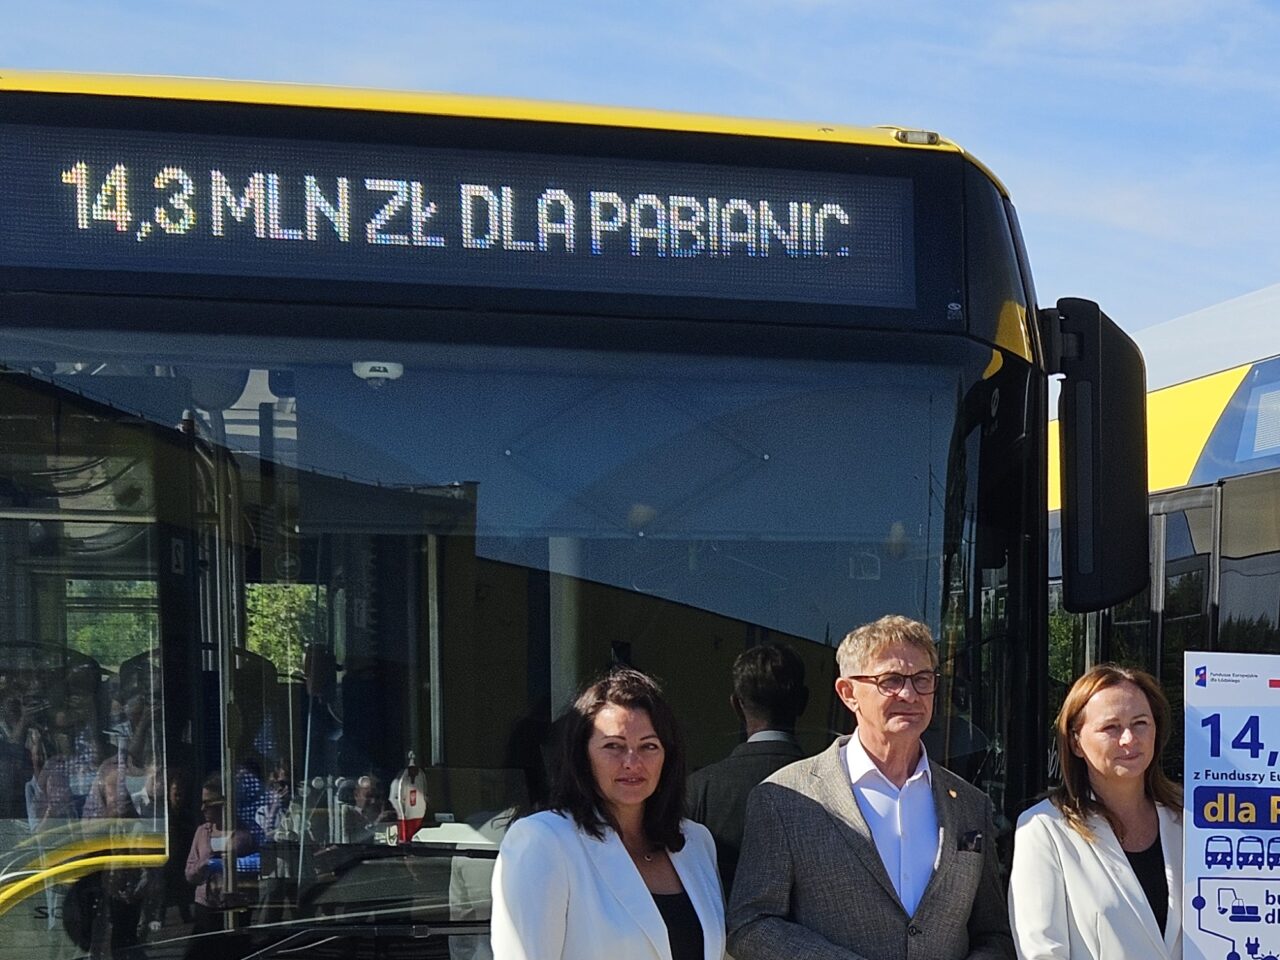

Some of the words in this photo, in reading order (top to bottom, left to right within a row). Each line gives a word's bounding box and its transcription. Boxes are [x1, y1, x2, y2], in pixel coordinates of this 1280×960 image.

[61, 162, 196, 242] 14,3
[211, 169, 350, 242] MLN
[365, 178, 447, 248] ZŁ
[461, 184, 577, 253] DLA
[590, 191, 850, 258] PABIANIC
[1194, 772, 1200, 780] z
[1204, 769, 1265, 784] Funduszy
[1203, 792, 1256, 823] dla
